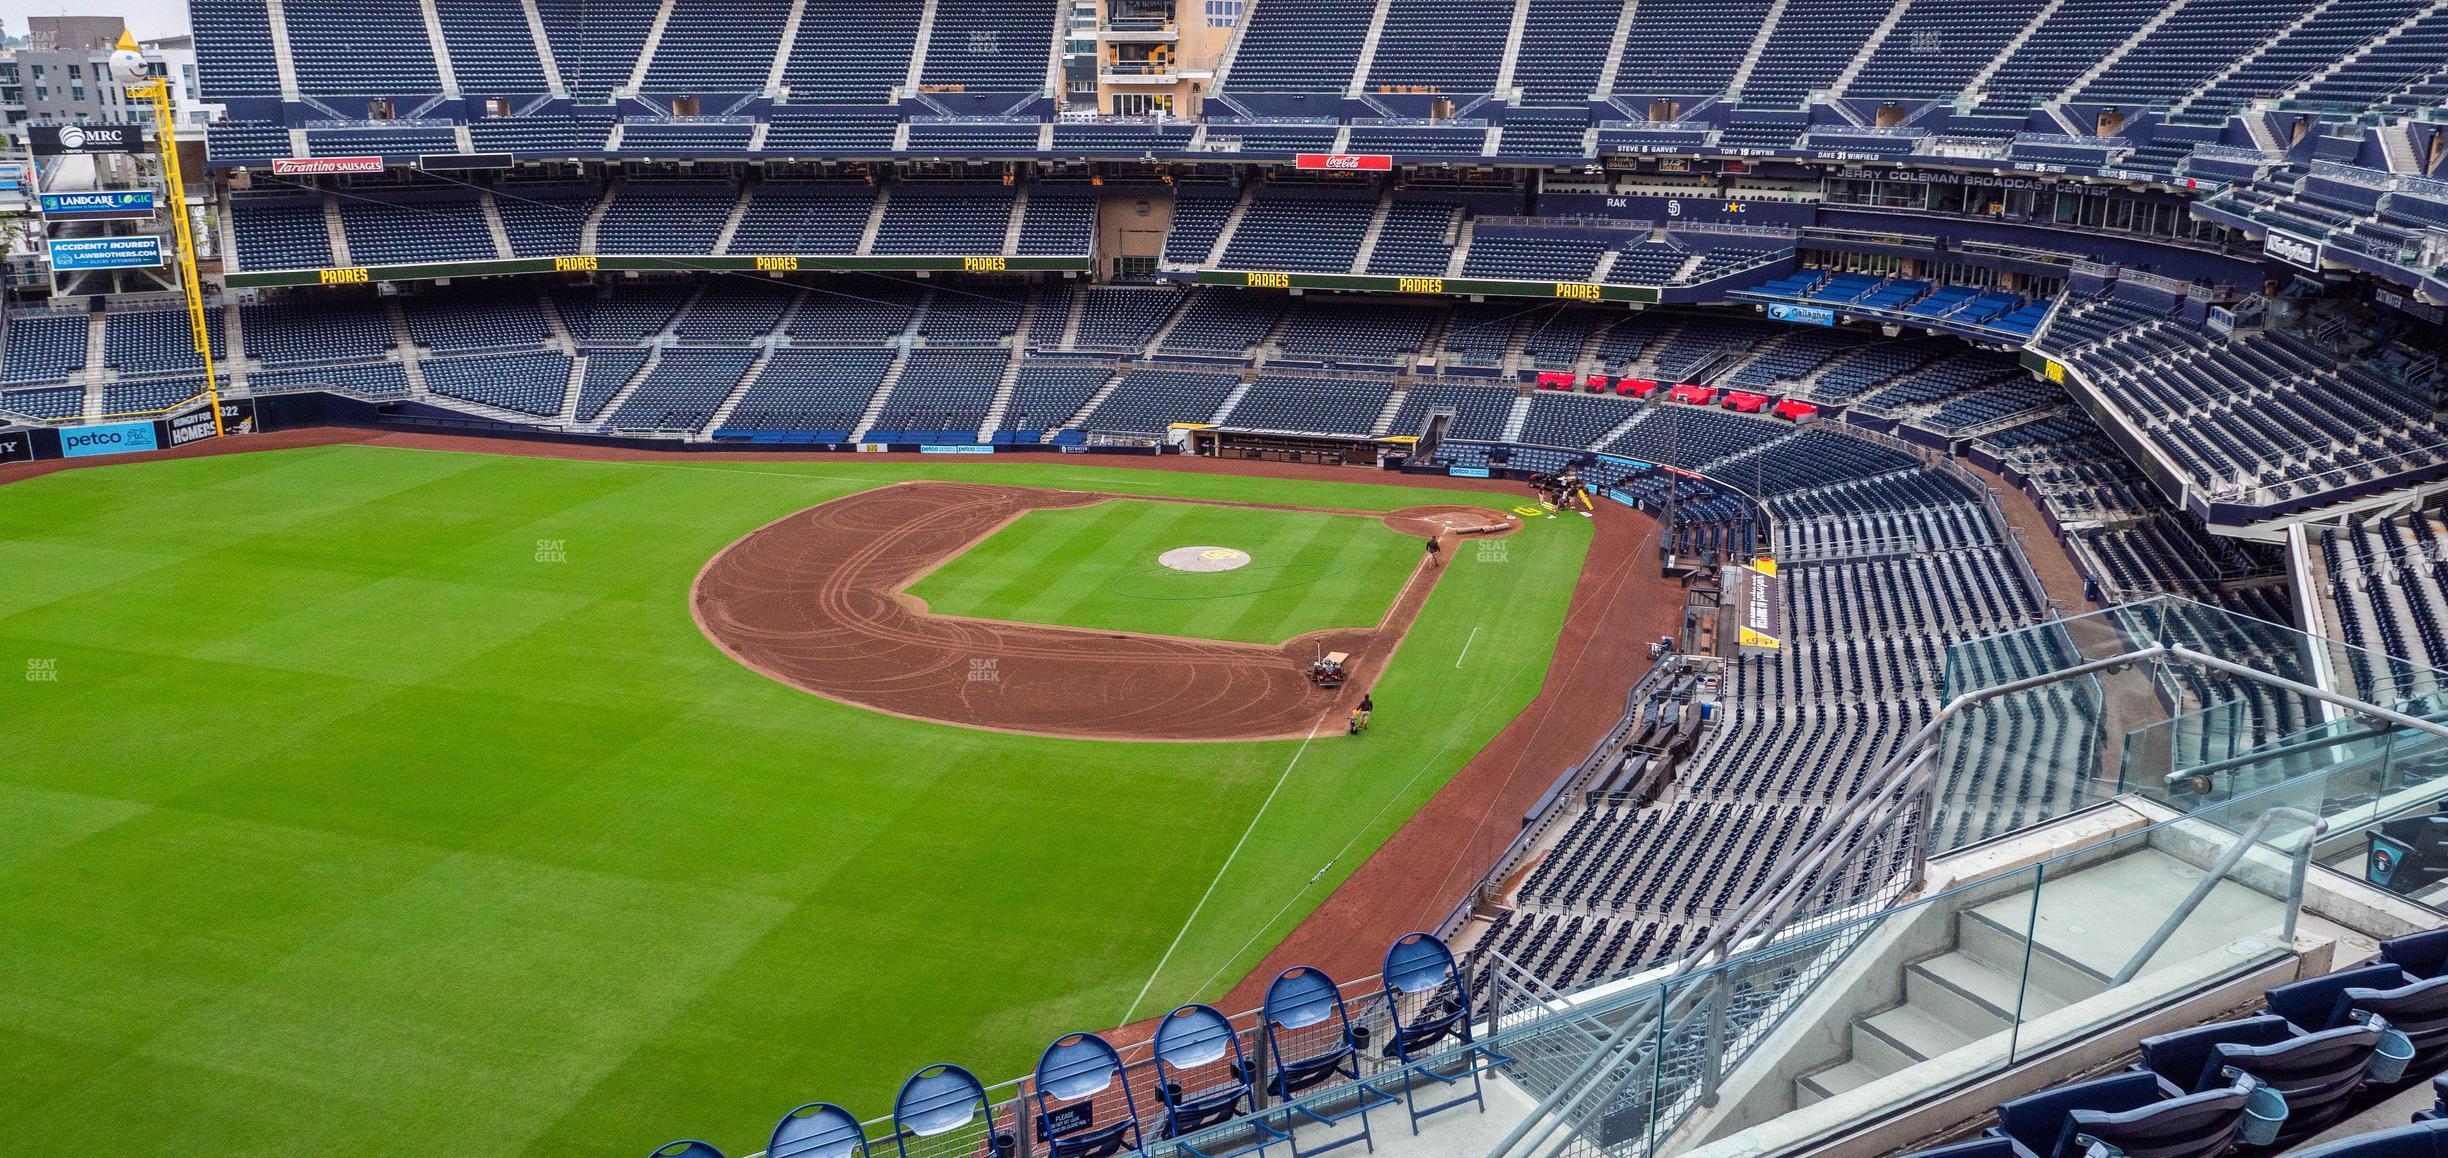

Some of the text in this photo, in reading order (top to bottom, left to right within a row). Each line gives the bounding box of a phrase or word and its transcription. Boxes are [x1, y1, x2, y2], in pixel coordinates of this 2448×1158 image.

[84, 130, 122, 141] MRC
[1740, 148, 1749, 156] 19
[1837, 152, 1846, 160] 31
[1847, 153, 1879, 161] WINFIELD
[276, 160, 381, 173] Tarantino SAUSAGES
[1326, 155, 1360, 168] Coca-Cola
[2035, 163, 2046, 172] 35
[2118, 170, 2127, 180] 51
[1837, 168, 2109, 196] JERRY COLEMAN BROADCAST CENTER
[60, 194, 151, 206] LANDCARE LOGIC
[1607, 198, 1626, 208] RAK
[54, 241, 155, 251] ACCIDENT? INJURED?
[74, 250, 157, 260] LAWBROTHERS.COM
[555, 257, 598, 271] PADRES
[757, 257, 798, 270] PADRES
[965, 257, 1006, 271] PADRES
[321, 268, 368, 284] PADRES
[1248, 273, 1289, 287] PADRES
[1400, 278, 1442, 293] PADRES
[1556, 283, 1600, 299] PADRES
[219, 406, 239, 417] 322
[173, 411, 212, 428] HUNGRY FOR
[171, 421, 217, 444] HOMERS
[66, 430, 122, 450] petco
